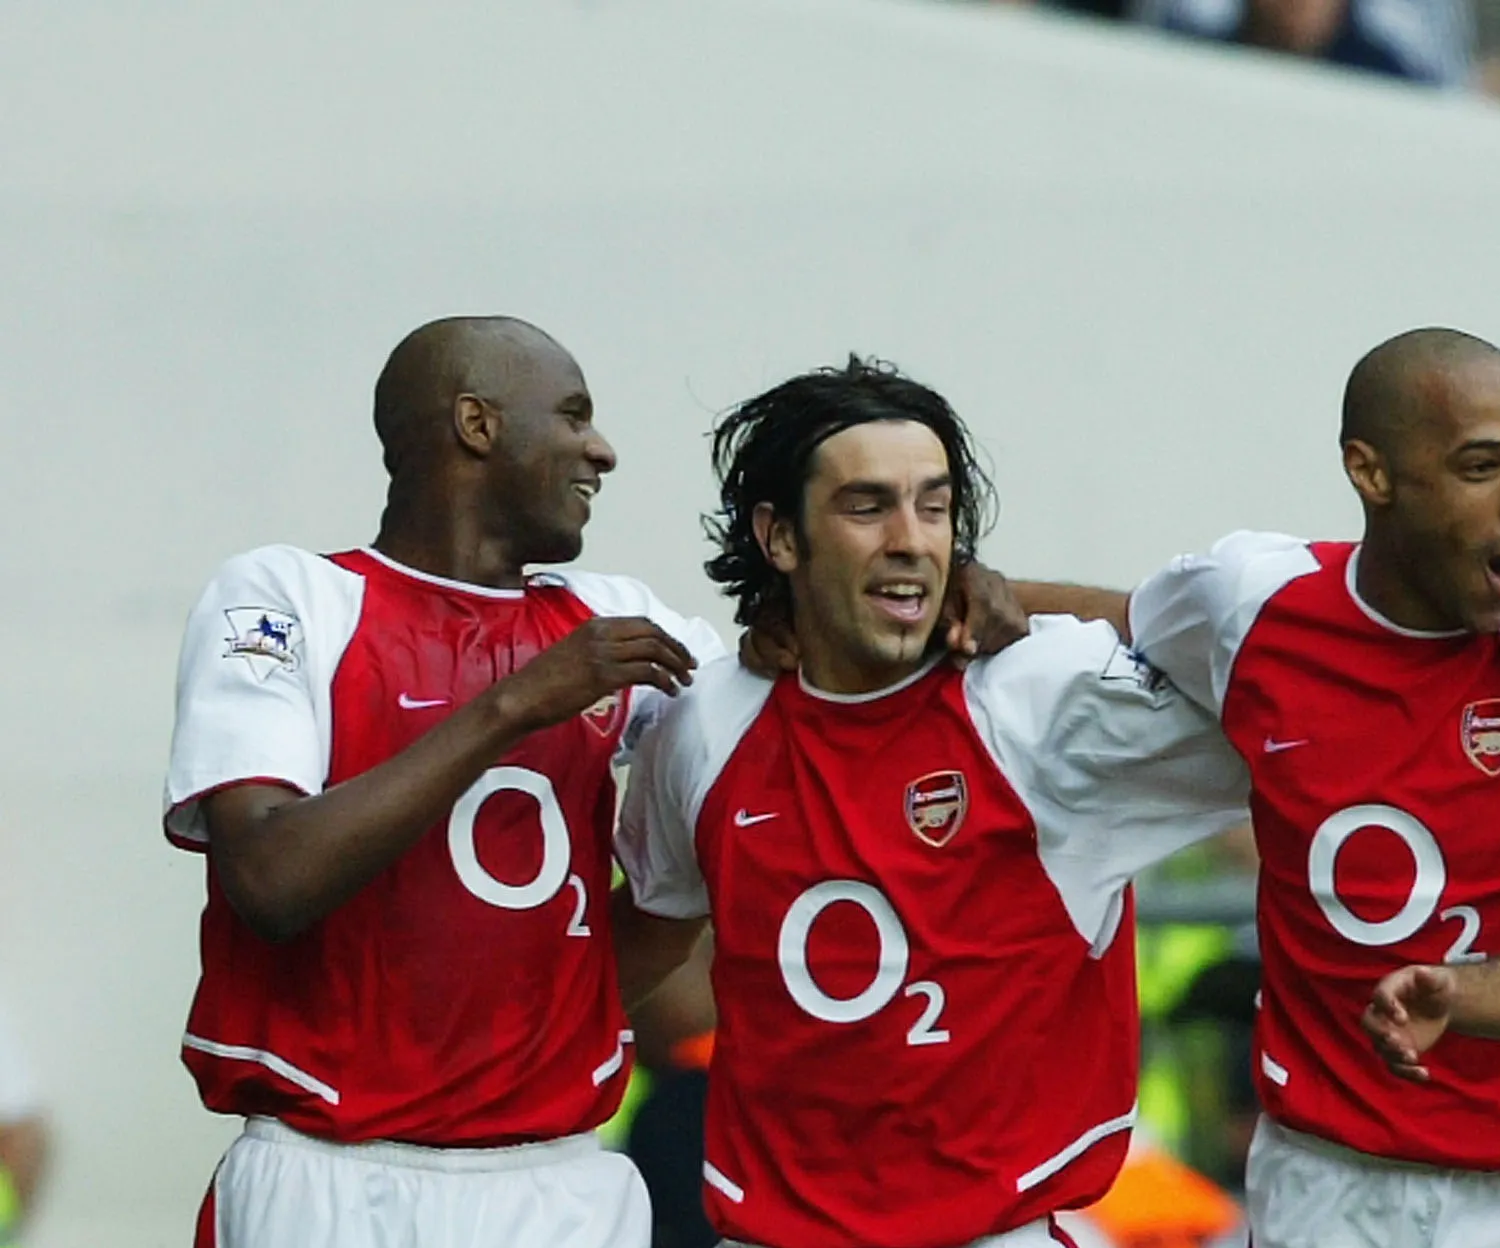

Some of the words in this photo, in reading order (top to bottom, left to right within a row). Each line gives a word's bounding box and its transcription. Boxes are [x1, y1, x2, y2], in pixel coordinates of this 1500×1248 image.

[448, 766, 591, 936] O2
[1308, 804, 1487, 964] O2
[778, 880, 950, 1046] O2
